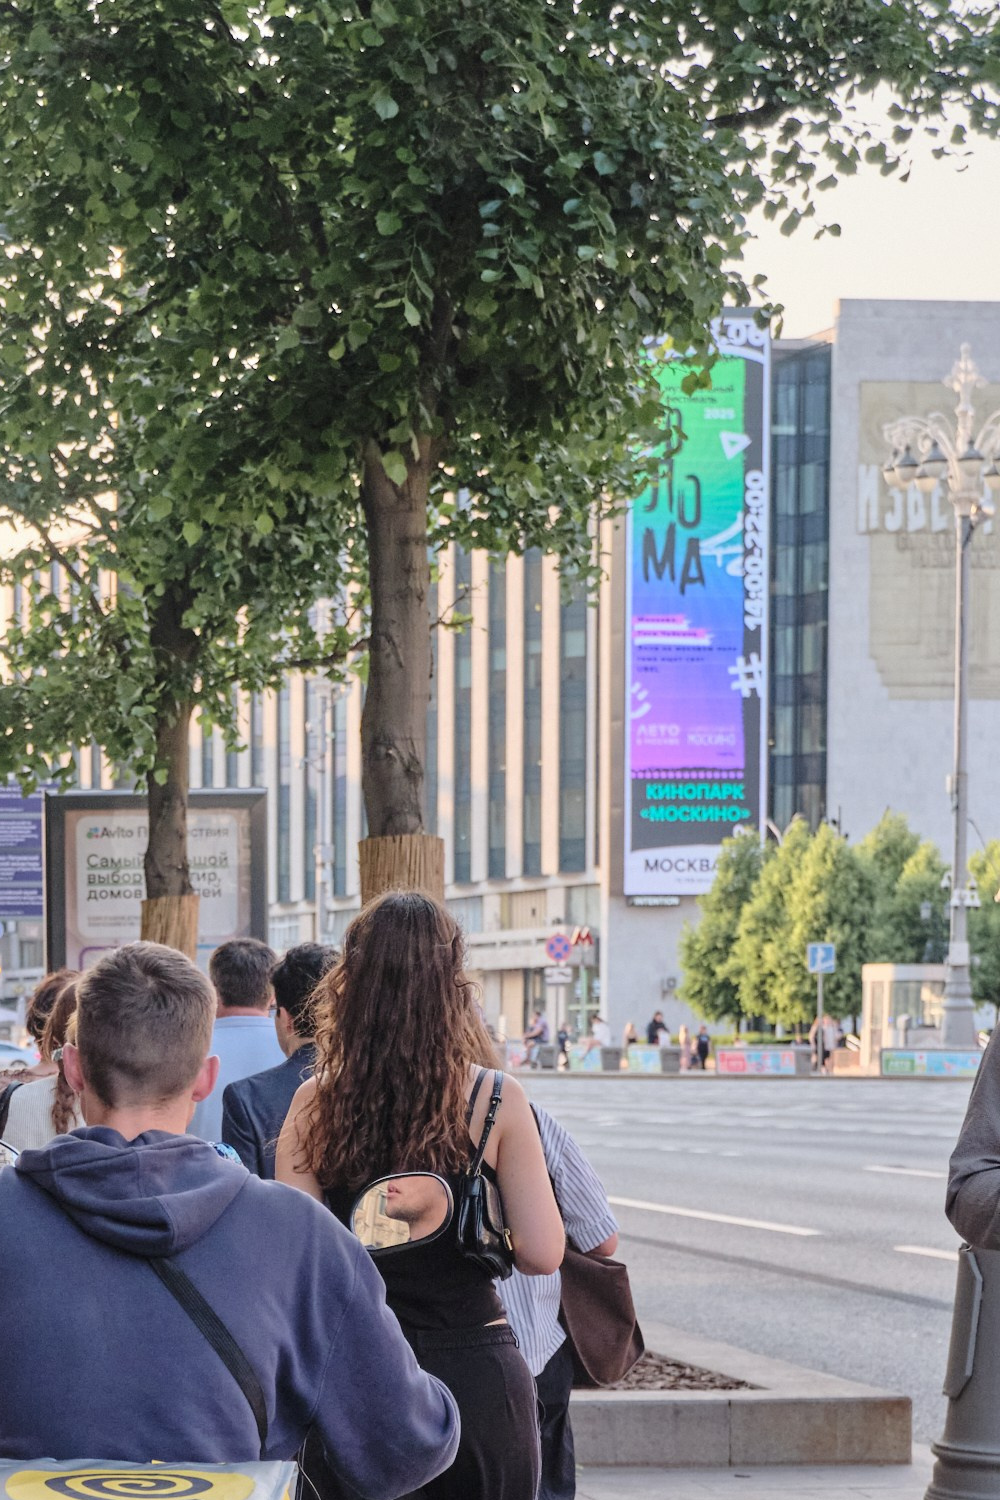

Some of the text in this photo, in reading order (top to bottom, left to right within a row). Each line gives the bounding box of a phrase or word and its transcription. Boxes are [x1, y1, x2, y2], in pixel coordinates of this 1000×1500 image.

[645, 783, 745, 800] КИНОПАРК
[640, 805, 751, 822] «МОСКИНО»
[100, 827, 229, 839] Avito Пствия
[87, 869, 143, 885] выбор
[87, 888, 143, 901] домов
